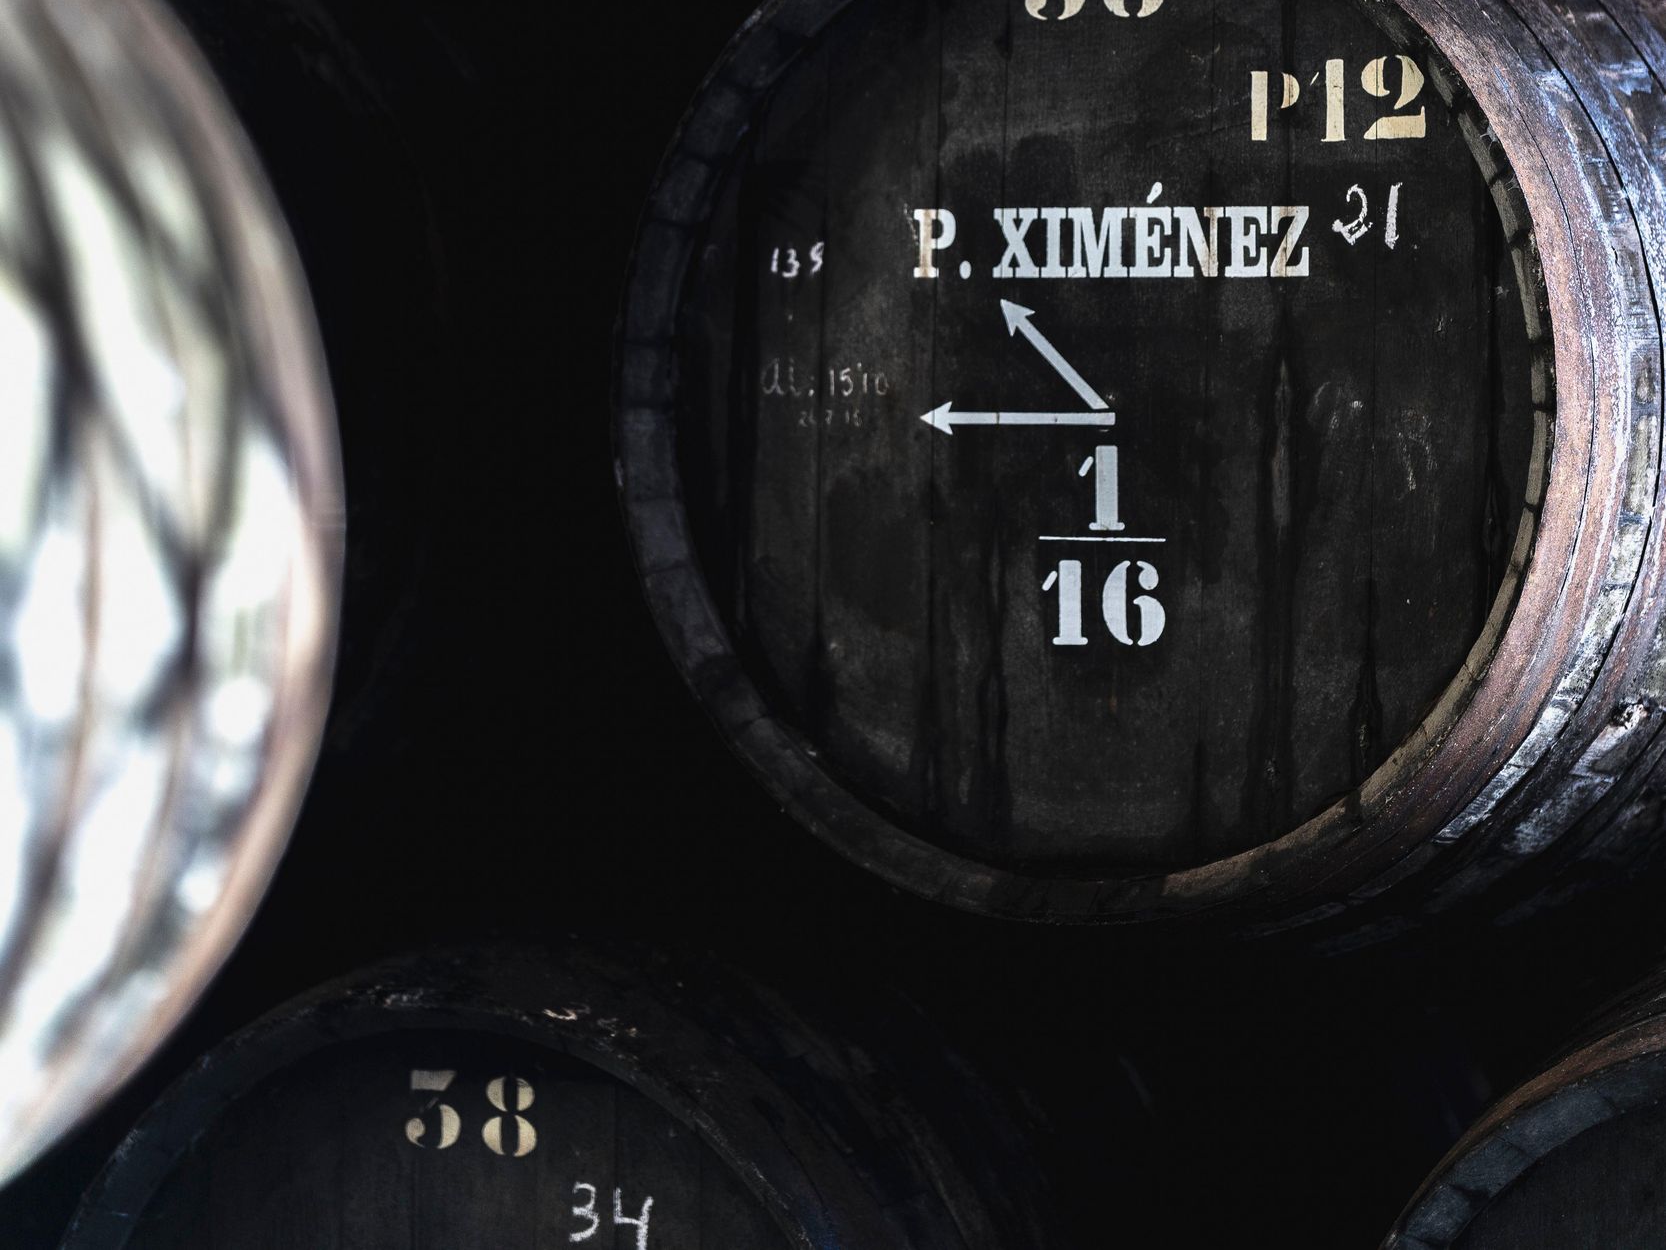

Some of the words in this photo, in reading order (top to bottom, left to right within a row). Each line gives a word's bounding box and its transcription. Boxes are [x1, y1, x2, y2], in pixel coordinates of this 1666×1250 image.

[913, 209, 971, 279] P.
[993, 182, 1309, 278] XIMÉNEZ
[1332, 182, 1402, 249] 21
[1079, 445, 1125, 530] 1
[1042, 560, 1166, 646] 16
[405, 1070, 537, 1157] 38
[570, 1182, 653, 1250] 34
